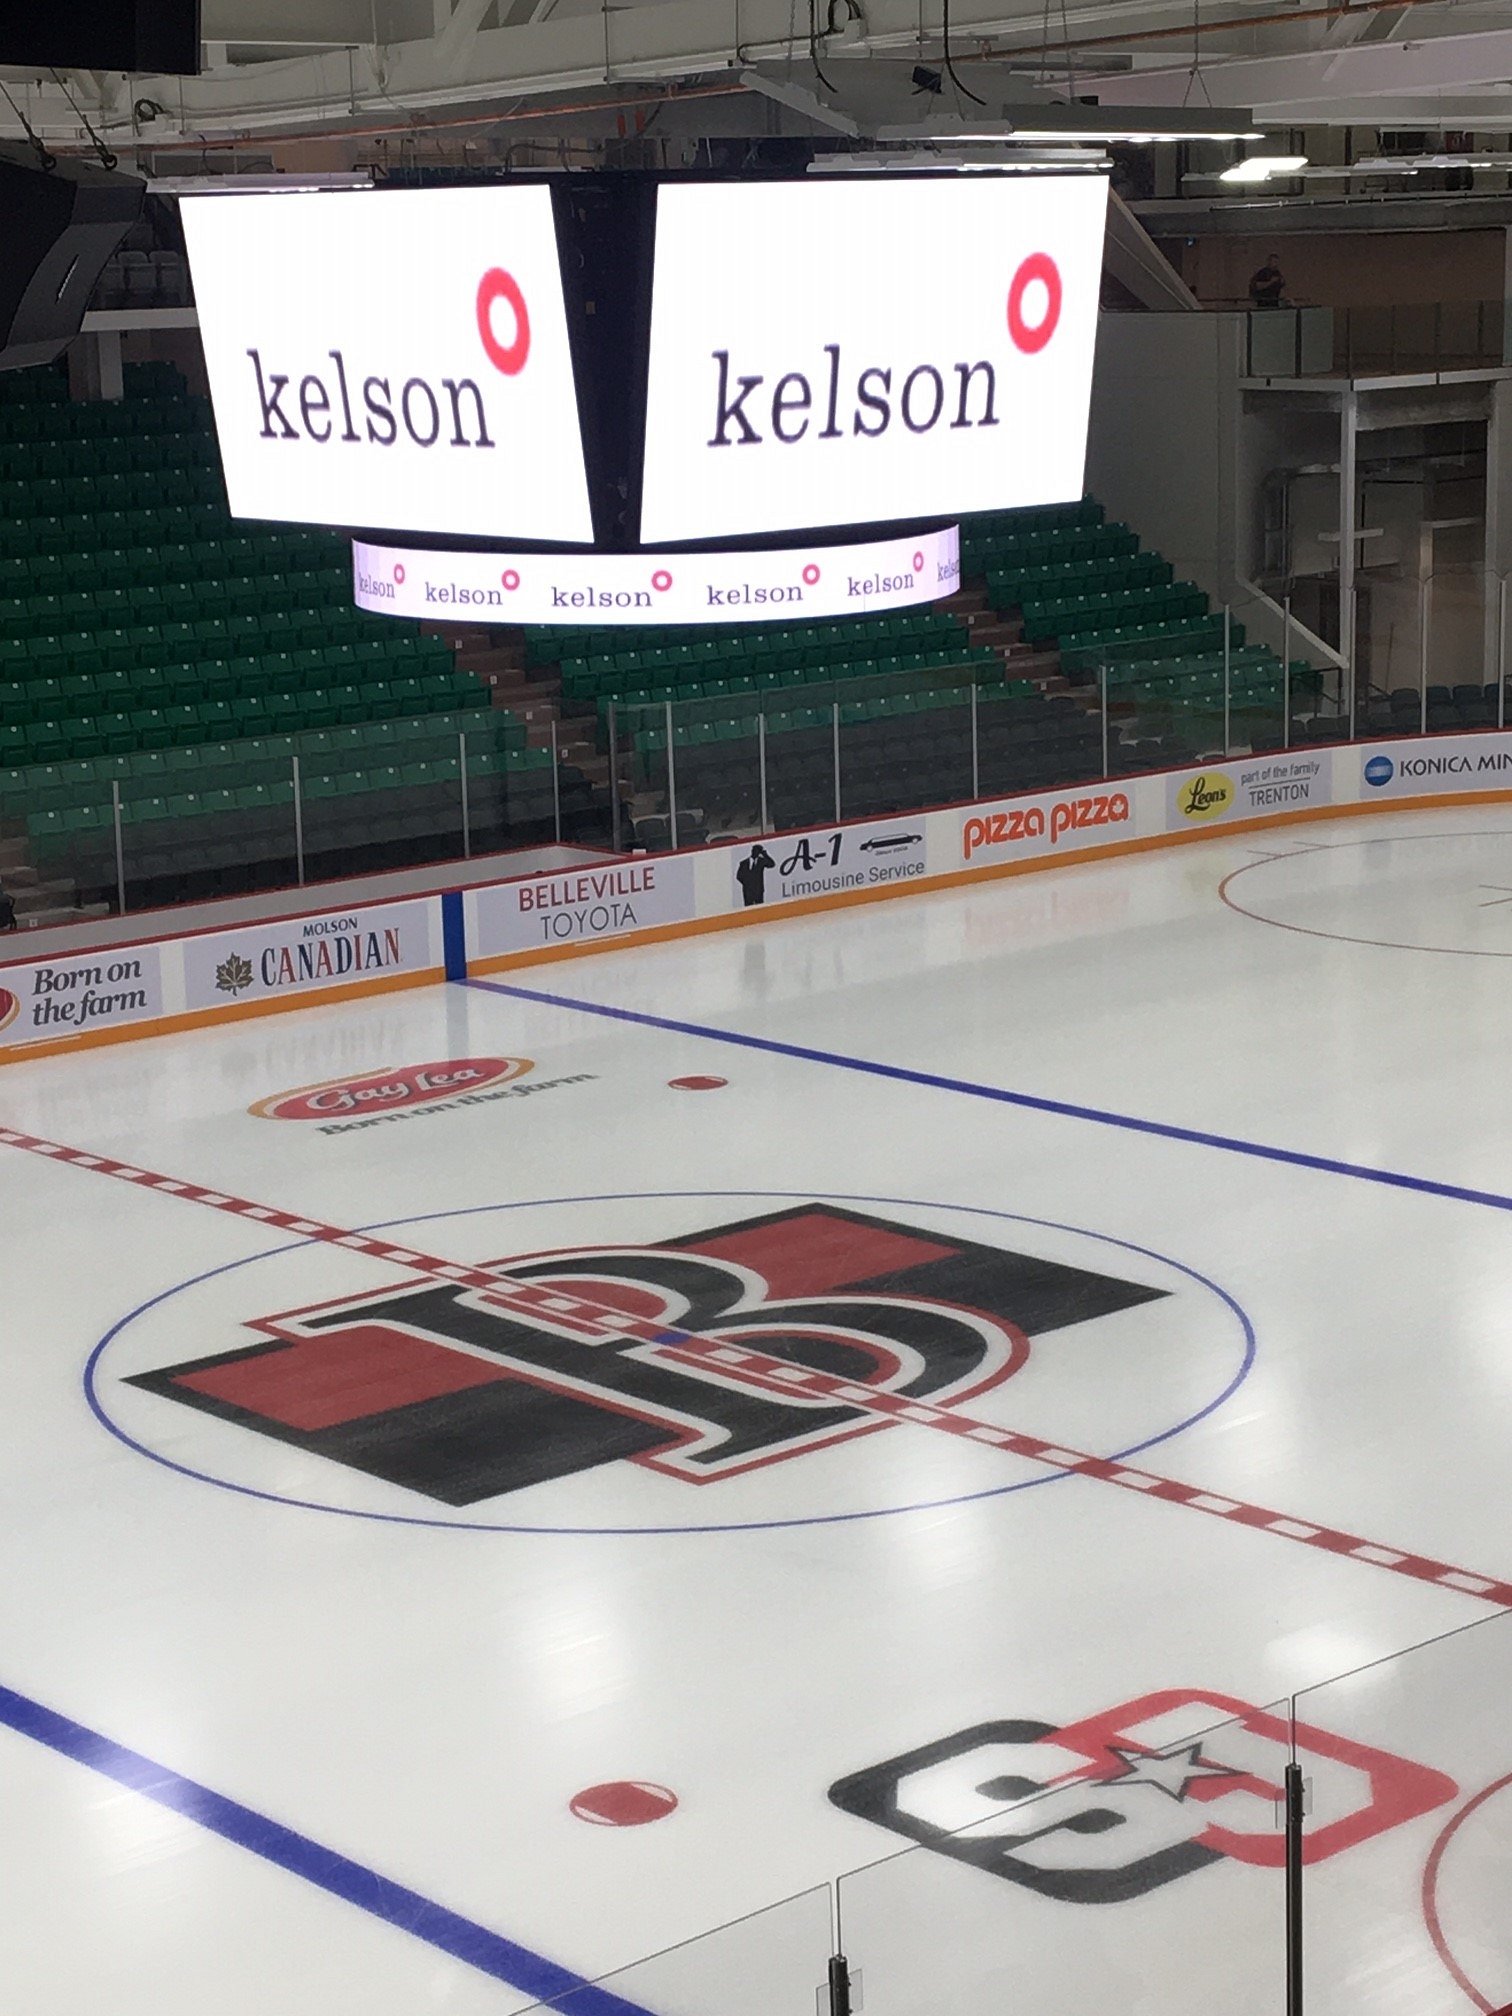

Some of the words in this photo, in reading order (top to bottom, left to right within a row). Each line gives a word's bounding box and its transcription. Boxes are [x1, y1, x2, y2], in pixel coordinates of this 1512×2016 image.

[246, 348, 496, 448] kelson
[706, 343, 1000, 448] kelson
[358, 572, 396, 599] kelson
[424, 582, 503, 606] kelson
[551, 586, 654, 608] kelson
[706, 583, 804, 606] kelson
[847, 570, 914, 597] kelson
[1241, 770, 1260, 786] part
[1261, 767, 1272, 780] of
[1273, 764, 1288, 778] the
[1289, 760, 1321, 776] family
[1400, 756, 1472, 777] KONICA
[1184, 776, 1227, 814] Leon's
[1248, 783, 1310, 807] TRENTON
[779, 833, 843, 877] A-1
[518, 866, 655, 912] BELLEVILLE
[781, 871, 865, 898] Limousine
[868, 861, 925, 883] Service
[302, 917, 358, 938] MOLSON
[540, 903, 638, 940] TOYOTA
[260, 927, 401, 986] CANADIAN
[32, 968, 102, 996] Born
[107, 960, 142, 982] on
[32, 997, 75, 1026] the
[73, 989, 147, 1026] farm
[306, 1080, 410, 1110] Gay
[414, 1068, 484, 1090] Lea
[315, 1112, 409, 1136] Born
[411, 1102, 459, 1117] on
[460, 1092, 510, 1107] the
[511, 1073, 601, 1097] farm
